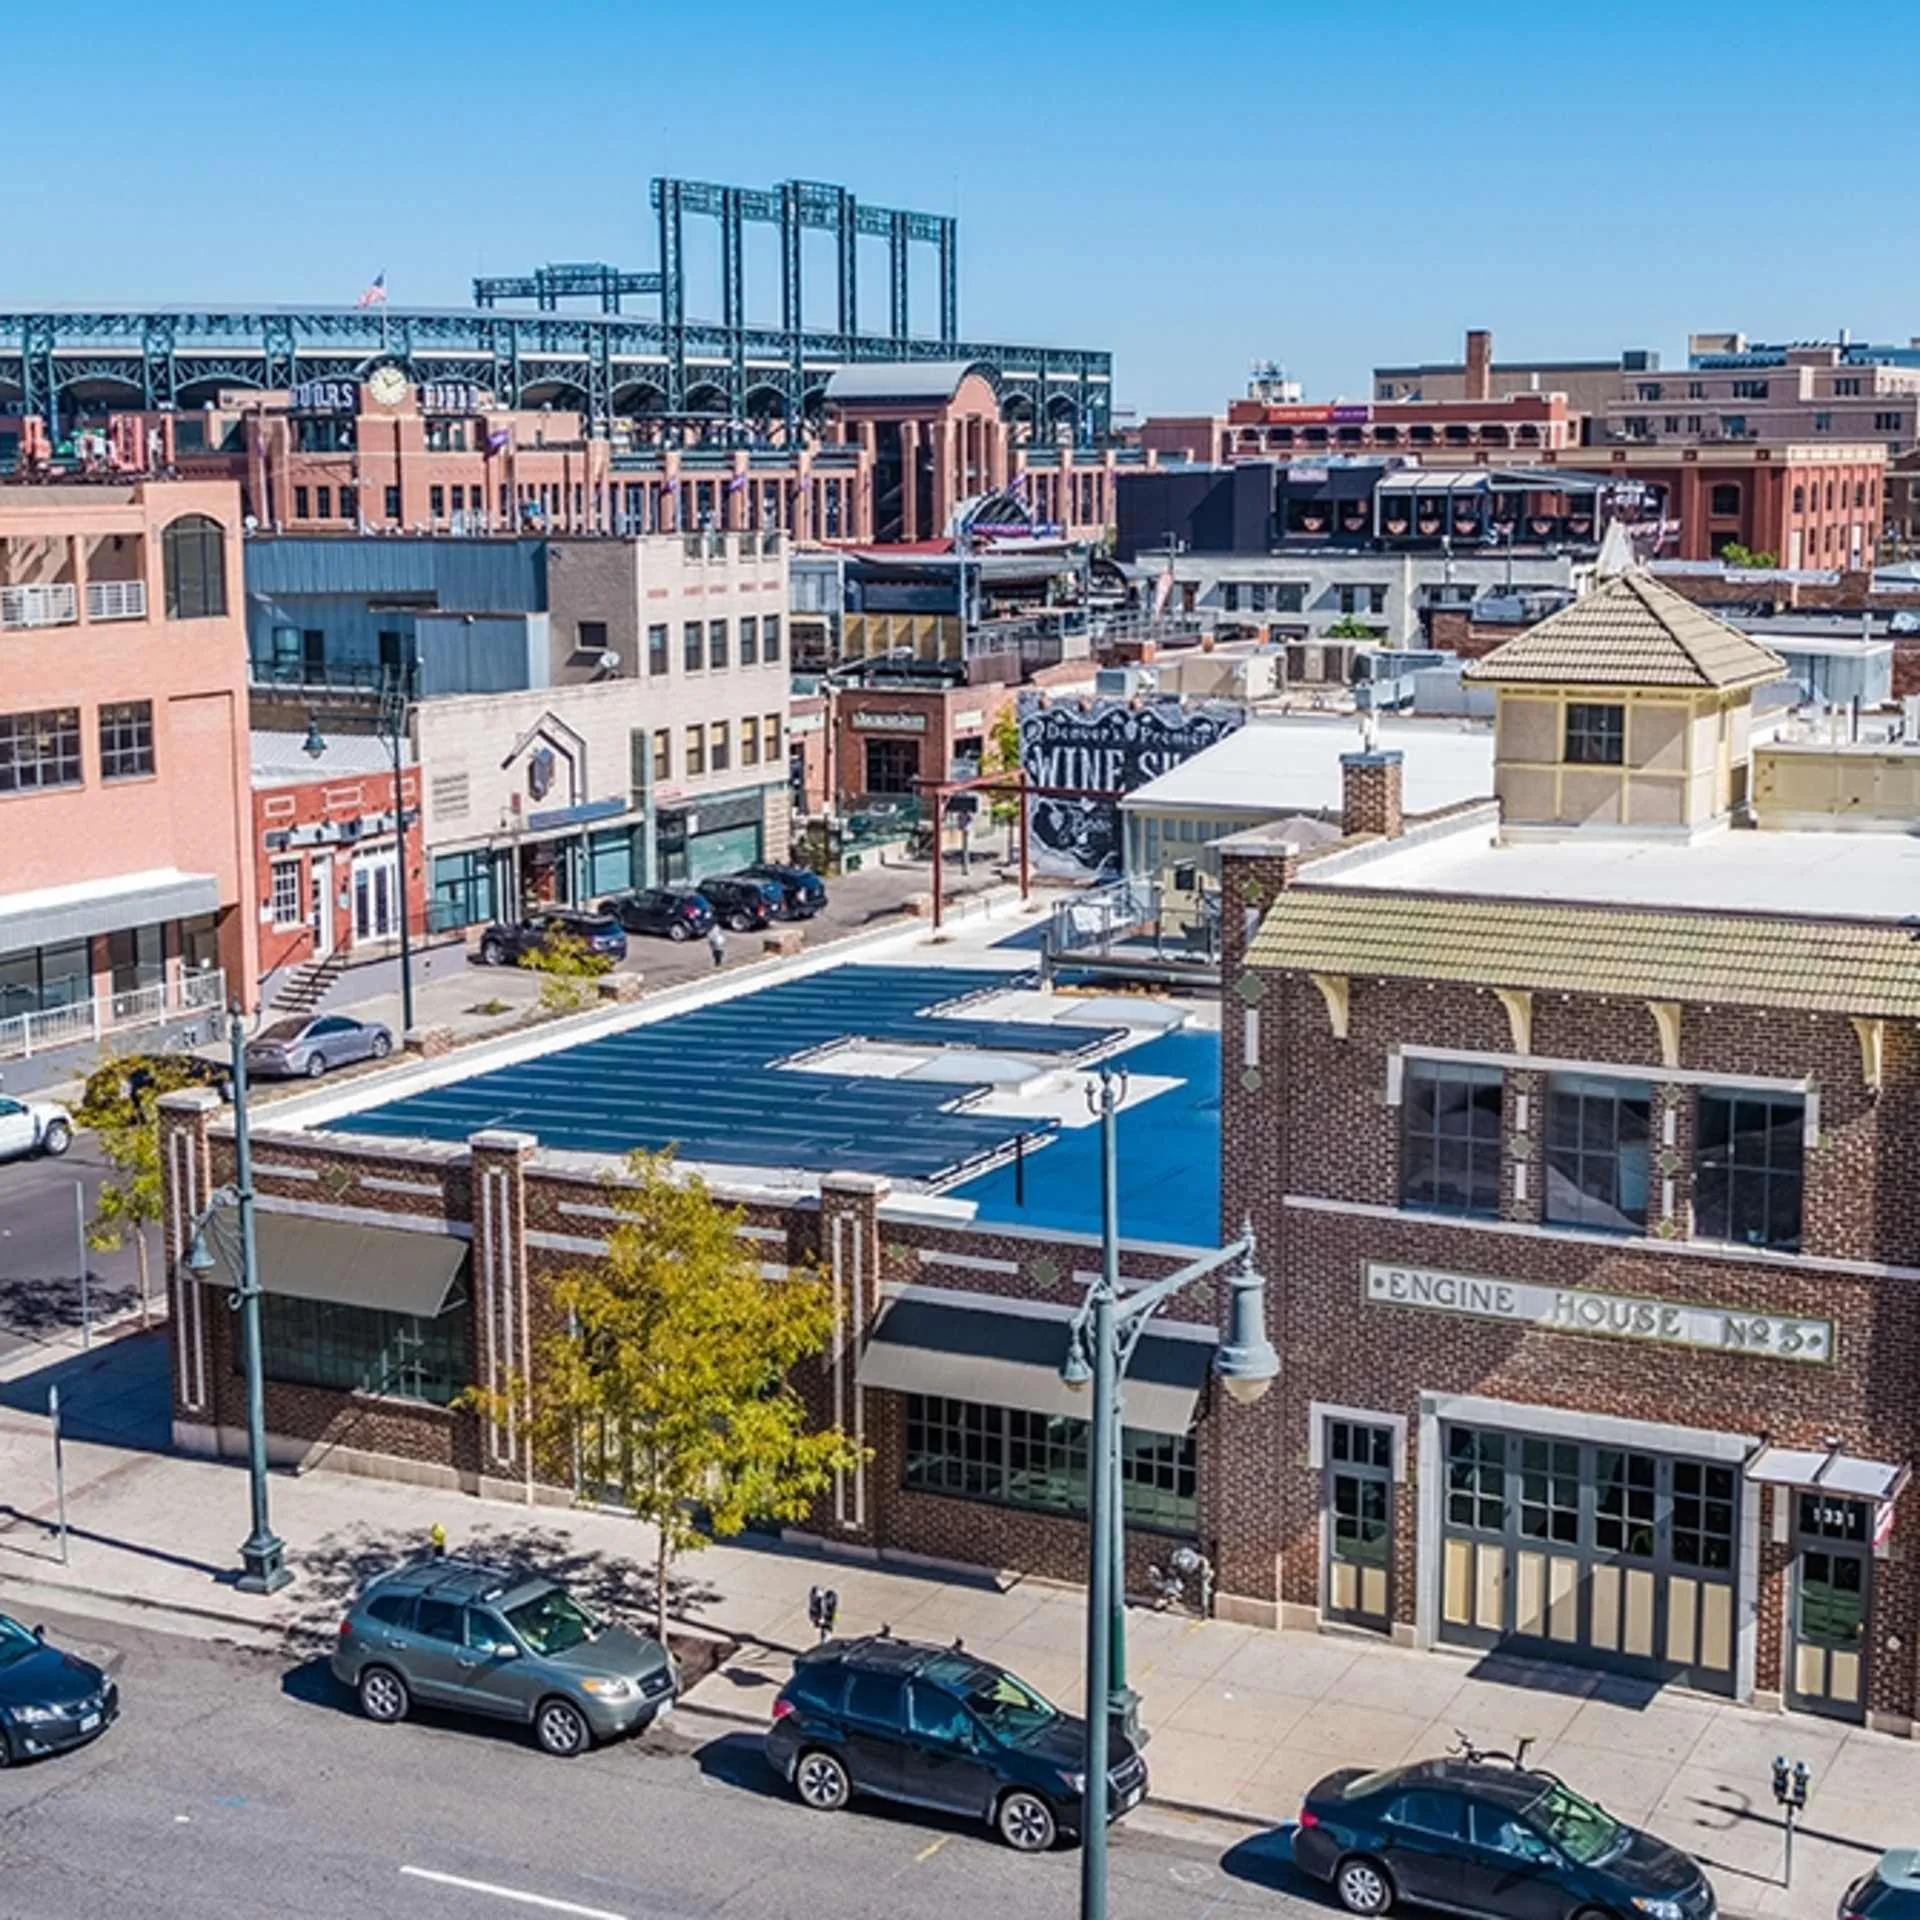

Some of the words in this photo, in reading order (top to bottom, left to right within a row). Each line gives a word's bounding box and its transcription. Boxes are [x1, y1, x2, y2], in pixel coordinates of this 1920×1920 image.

[1031, 746, 1126, 792] WINE
[1388, 1271, 1515, 1313] ENGINE
[1553, 1293, 1682, 1336] HOUSE
[1778, 1322, 1804, 1353] 5
